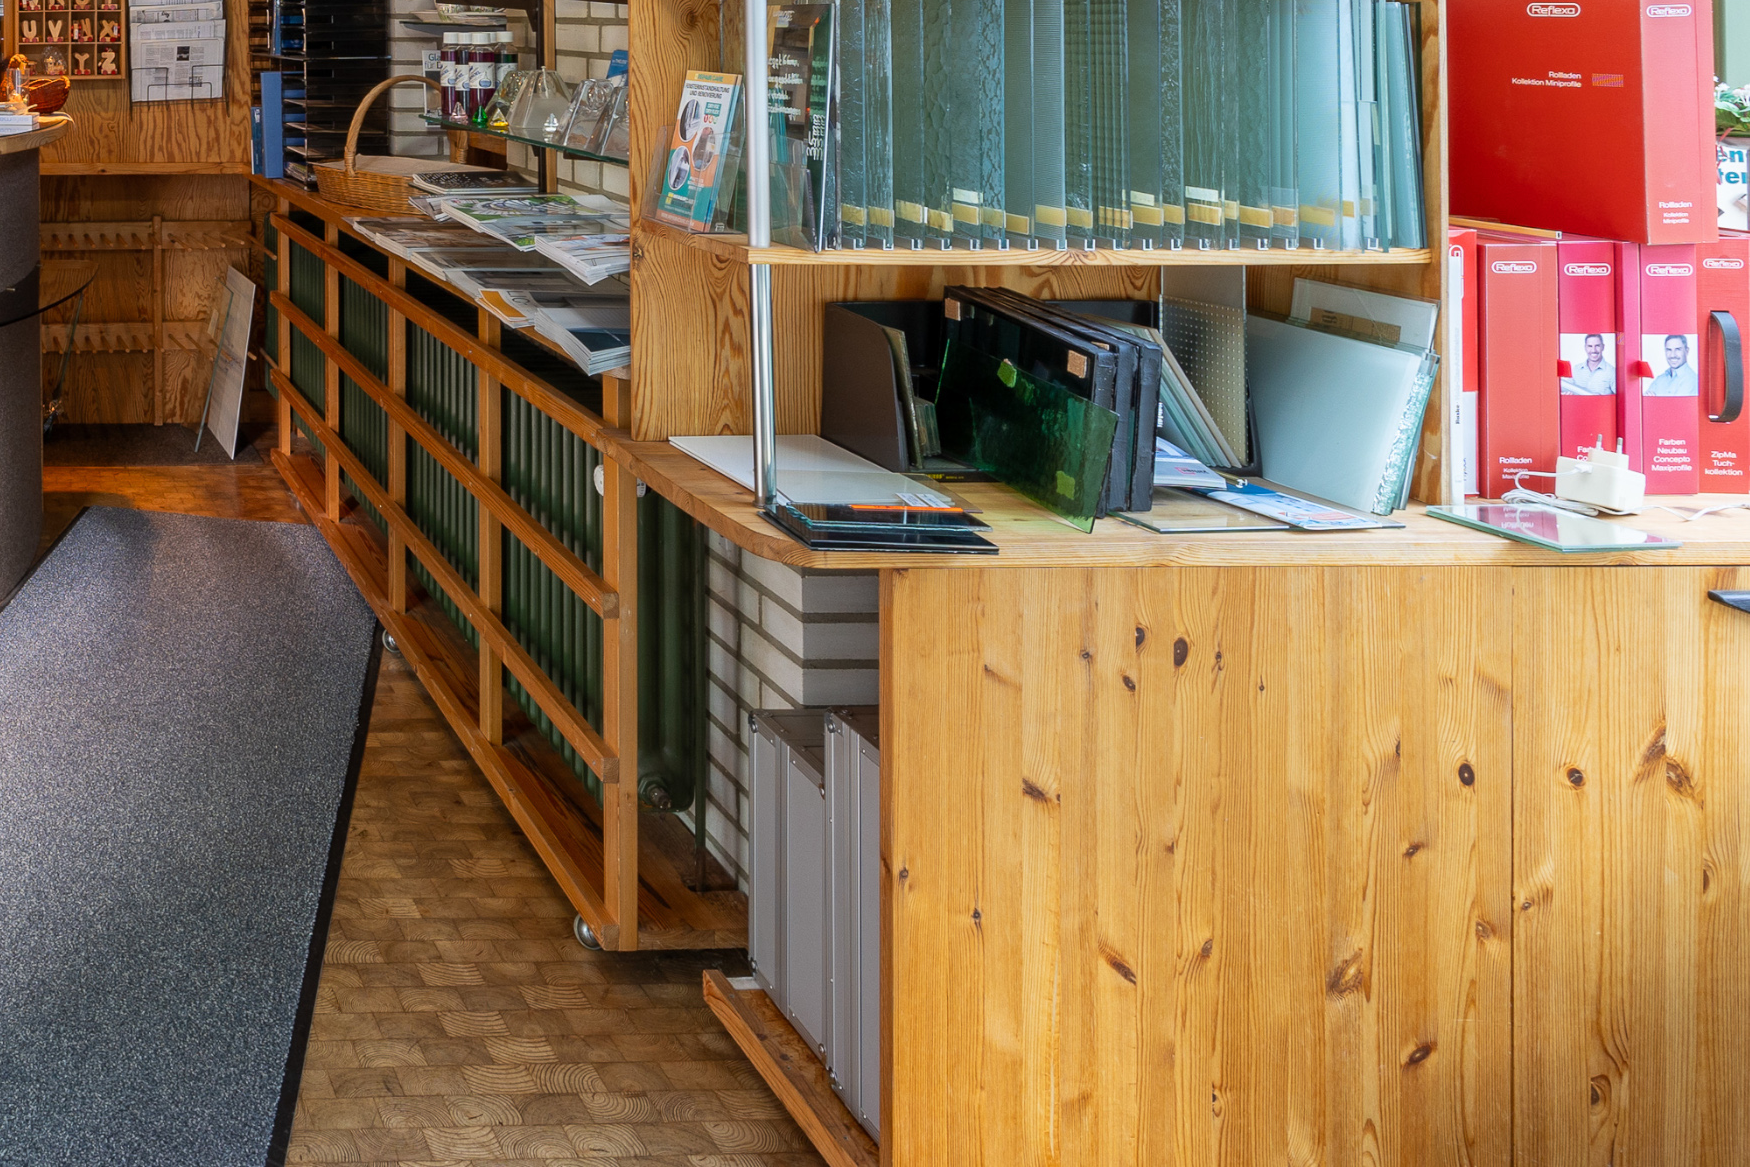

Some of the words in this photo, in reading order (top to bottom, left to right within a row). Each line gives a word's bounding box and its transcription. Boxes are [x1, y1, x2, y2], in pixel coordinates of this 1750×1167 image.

[1531, 4, 1576, 17] Reflexa
[1650, 7, 1688, 17] Reflexa
[1511, 78, 1545, 86] Kollektion
[1545, 79, 1581, 88] Miniprofile
[1496, 263, 1533, 273] Reflexa
[1706, 259, 1741, 269] Reflexa
[1568, 265, 1607, 275] Reflexa
[1650, 265, 1690, 275] Reflexa
[1658, 438, 1686, 446] Farben
[1653, 455, 1691, 464] Concepto
[1710, 450, 1737, 460] ZipMa
[1651, 464, 1692, 473] Maxiprofile
[1704, 468, 1743, 476] kollektion
